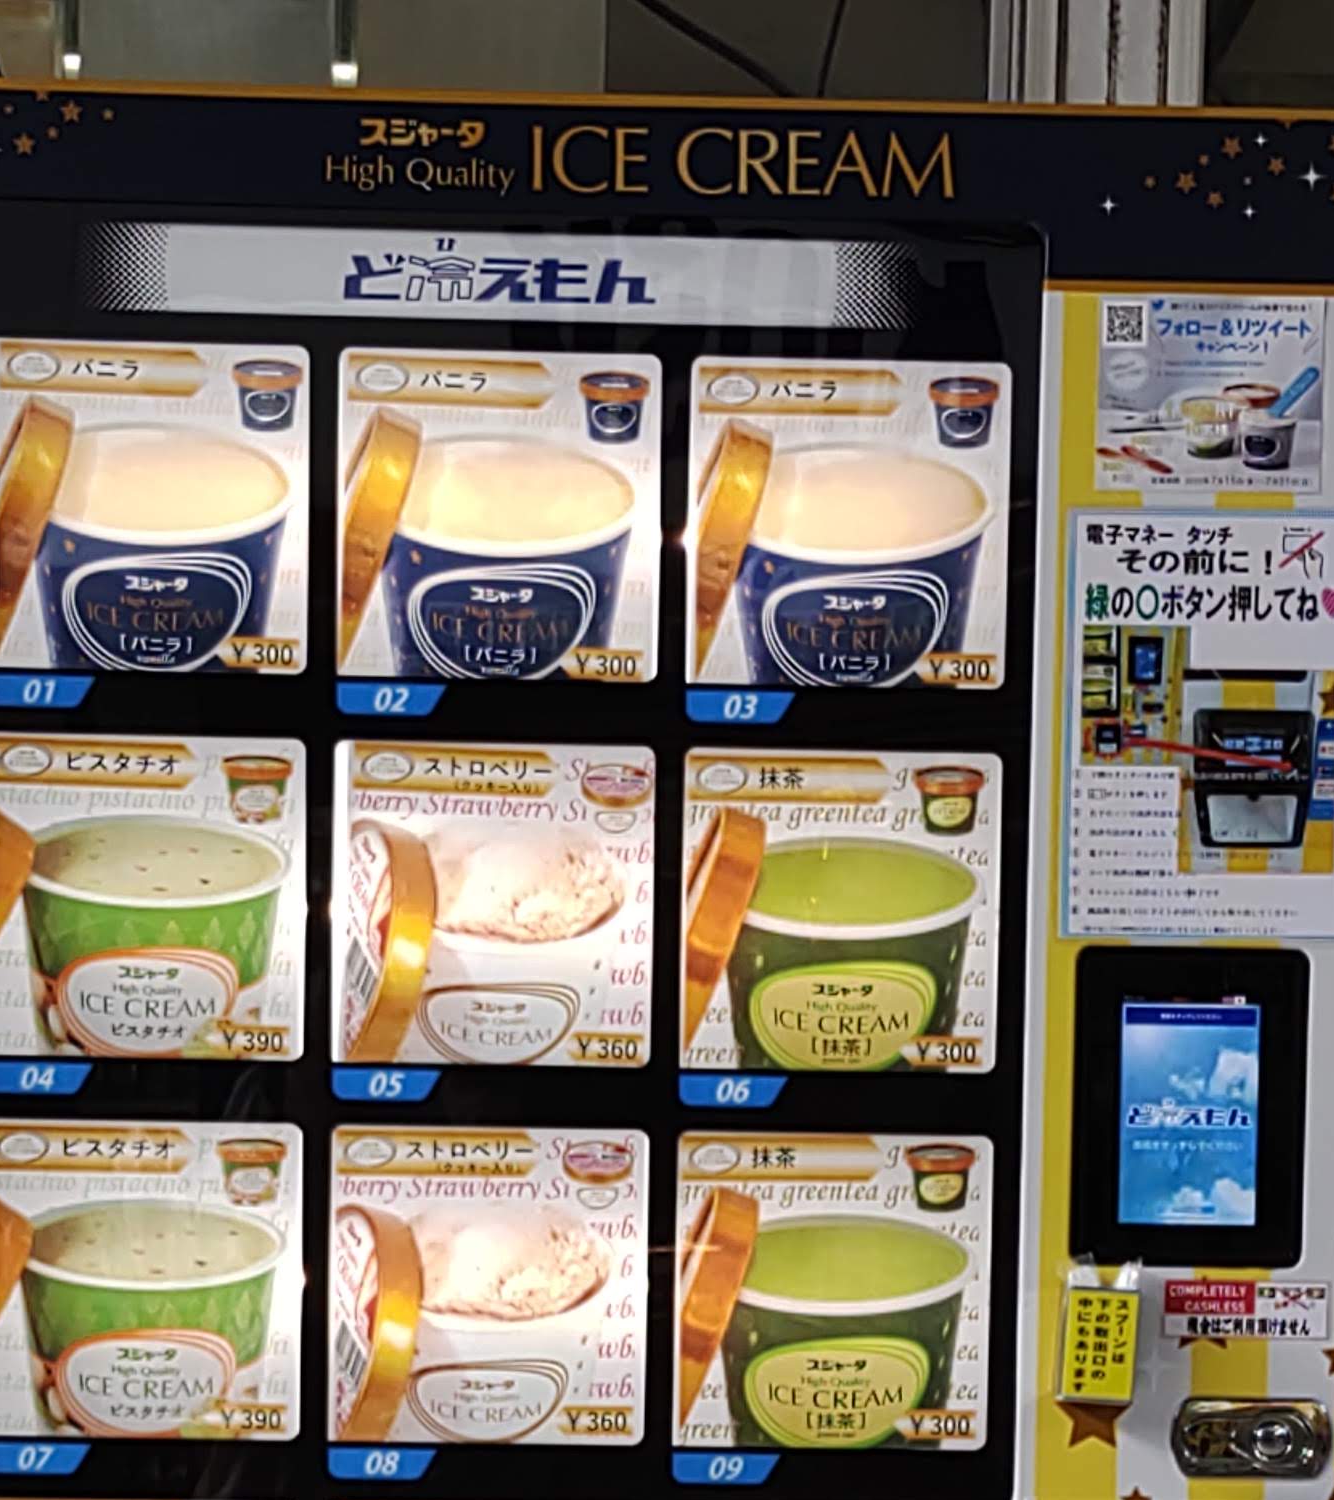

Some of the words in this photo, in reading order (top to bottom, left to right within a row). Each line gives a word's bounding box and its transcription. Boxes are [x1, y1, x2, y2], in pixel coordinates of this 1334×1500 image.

[359, 119, 485, 148] スジャータ
[324, 154, 394, 193] High
[406, 159, 516, 196] Quality
[532, 125, 650, 193] ICE
[676, 127, 955, 199] CREAM
[72, 357, 139, 380] バニラ
[420, 370, 488, 392] バニラ
[771, 380, 838, 401] バニラ
[1086, 524, 1174, 545] 電子マネー
[1188, 525, 1233, 545] タッチ
[22, 679, 55, 704] 01
[373, 688, 409, 712] 02
[723, 695, 758, 720] 03
[67, 751, 181, 775] ピスタチオ
[423, 756, 553, 780] ストロベリー
[759, 767, 804, 790] 抹茶
[422, 796, 557, 823] Strawberry
[787, 803, 887, 830] greentea
[20, 1064, 55, 1090] 04
[369, 1072, 404, 1097] 05
[716, 1078, 750, 1103] 06
[63, 1138, 176, 1159] ピスタチオ
[405, 1140, 534, 1161] ストロベリー
[751, 1147, 796, 1169] 抹茶
[406, 1177, 541, 1204] Strawberry
[780, 1182, 879, 1209] greentea
[1169, 1285, 1247, 1298] COMPLETELY
[1184, 1300, 1246, 1313] CASHLESS
[18, 1447, 54, 1471] 07
[364, 1451, 399, 1476] 08
[708, 1457, 744, 1481] 09
